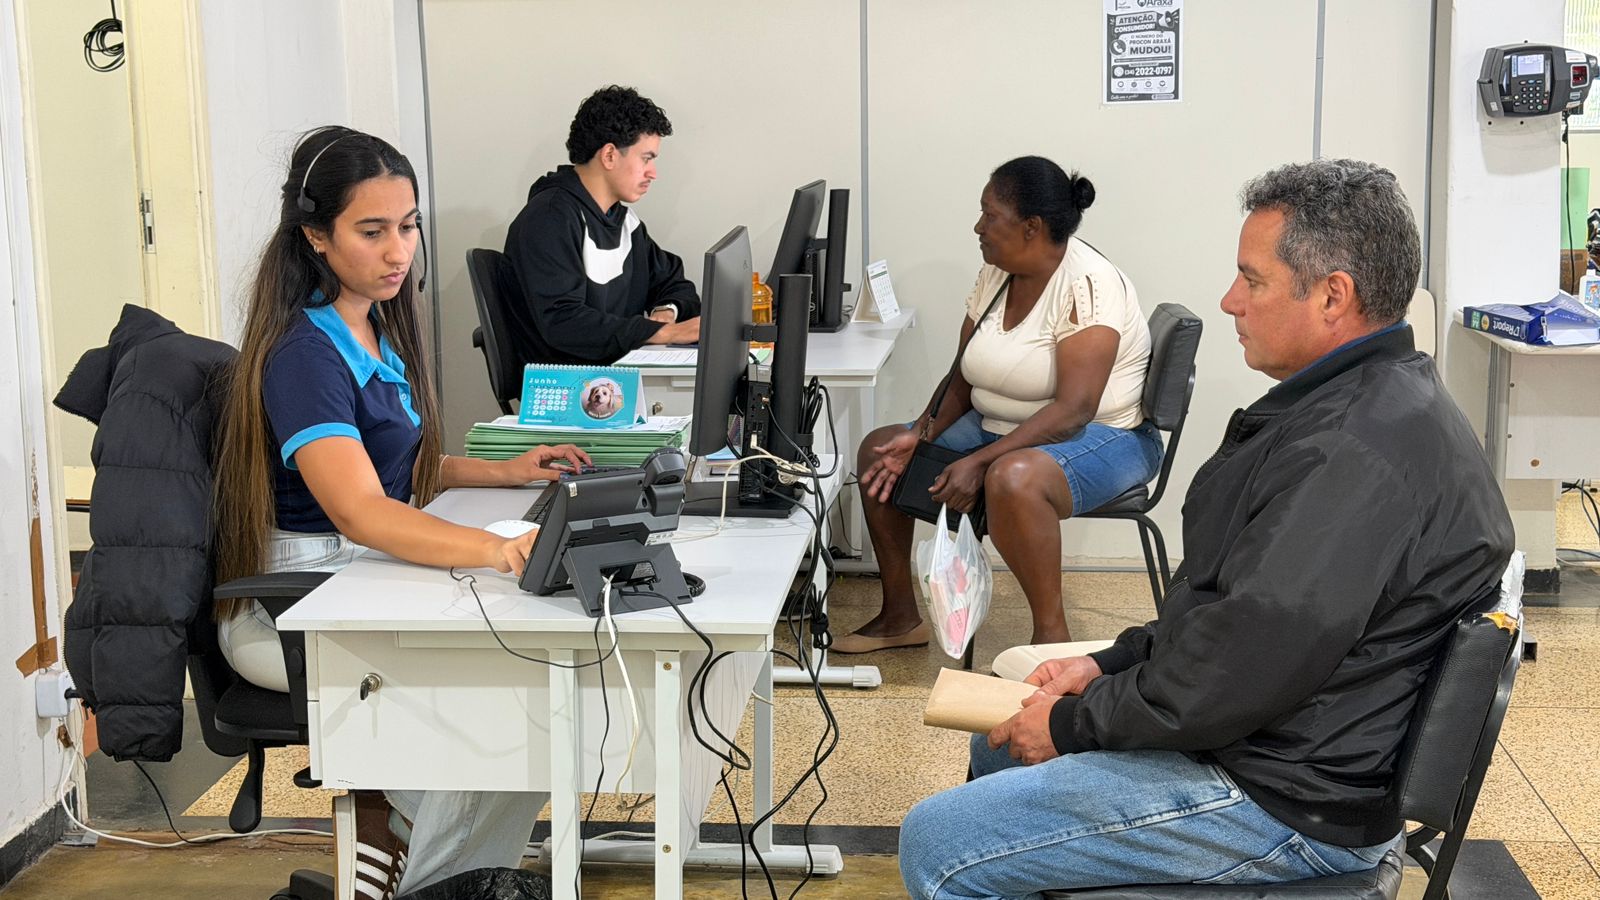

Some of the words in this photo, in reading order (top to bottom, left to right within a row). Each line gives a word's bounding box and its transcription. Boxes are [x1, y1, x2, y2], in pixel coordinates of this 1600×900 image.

[1119, 14, 1154, 24] ATENÇÃO,
[1114, 23, 1156, 33] CONSUMIDOR!
[1130, 46, 1171, 55] MUDOU!
[1135, 66, 1172, 76] 2022-0797
